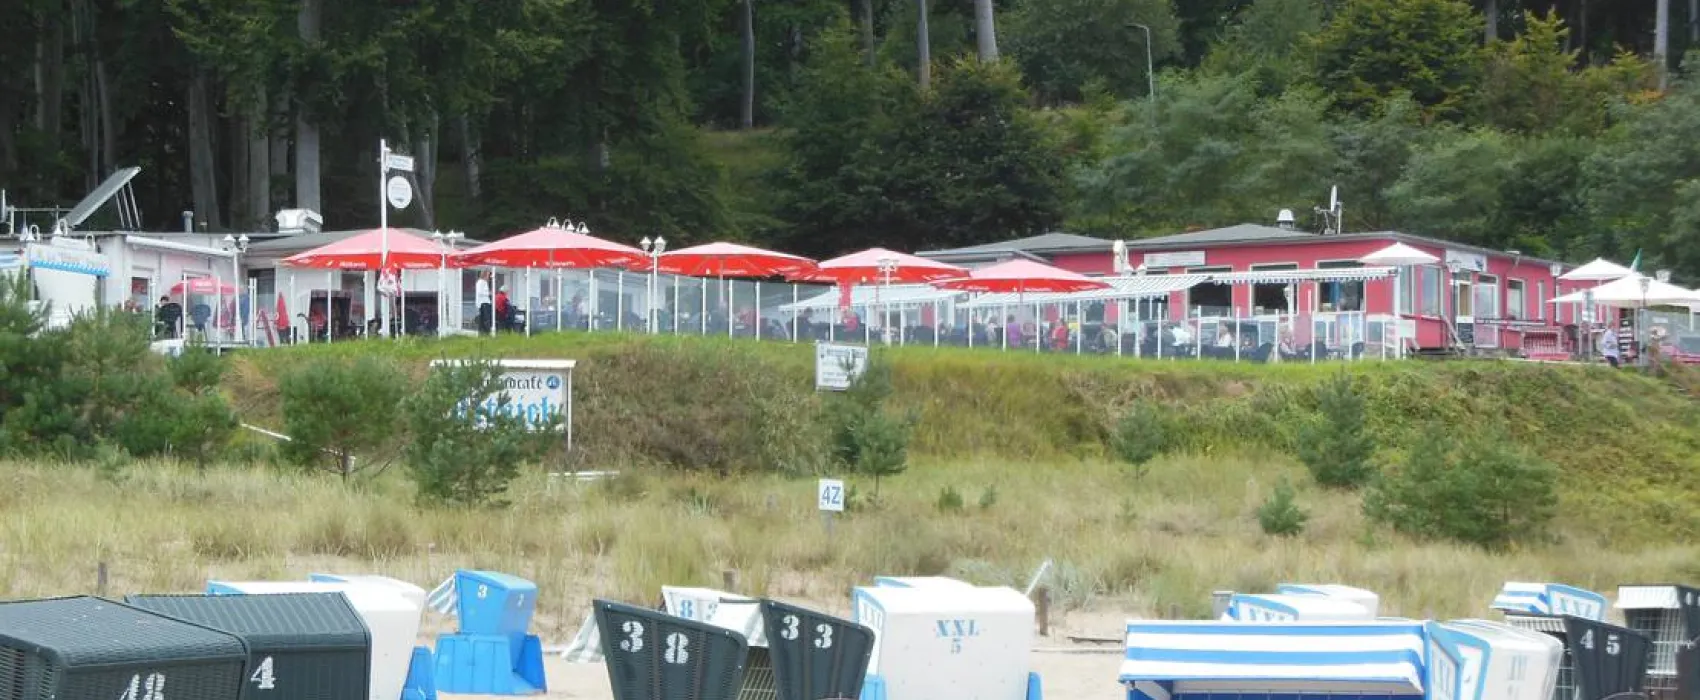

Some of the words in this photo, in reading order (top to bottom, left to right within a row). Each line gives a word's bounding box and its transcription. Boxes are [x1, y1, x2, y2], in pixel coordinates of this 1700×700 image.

[477, 584, 488, 599] 3
[935, 618, 982, 638] XXL
[950, 638, 962, 655] 5
[1580, 627, 1621, 656] 45
[250, 655, 277, 690] 4
